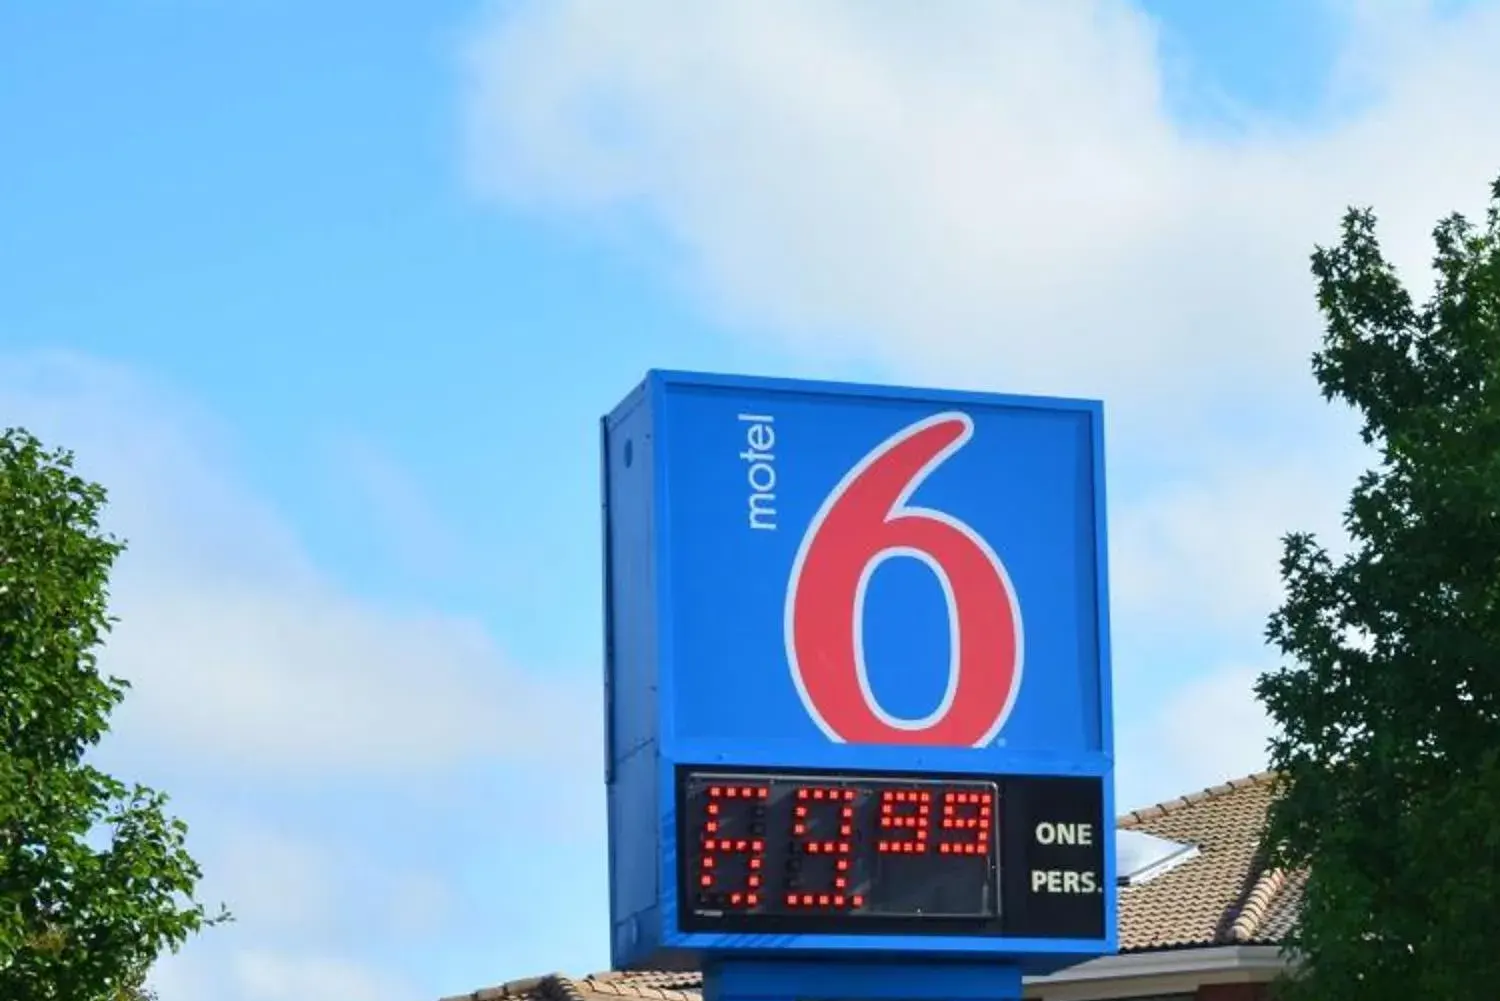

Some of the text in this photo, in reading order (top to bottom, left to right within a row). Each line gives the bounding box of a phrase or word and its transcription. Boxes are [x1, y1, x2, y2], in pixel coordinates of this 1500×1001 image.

[737, 412, 777, 530] motel
[783, 410, 1025, 749] 6
[1035, 822, 1093, 846] ONE
[1031, 871, 1103, 894] PERS.
